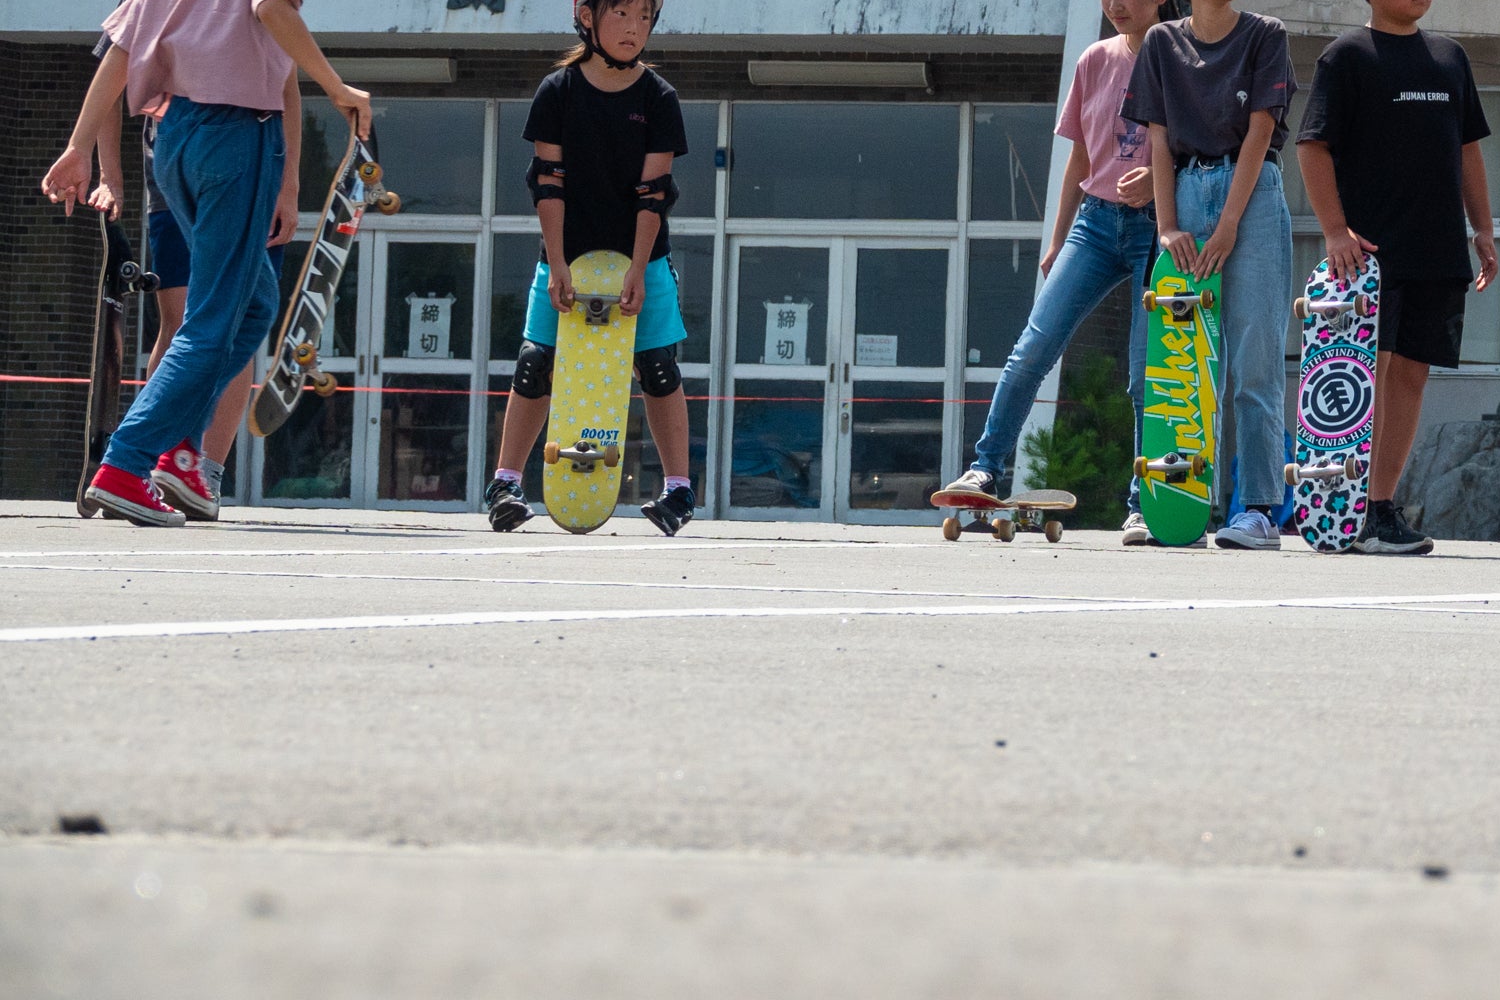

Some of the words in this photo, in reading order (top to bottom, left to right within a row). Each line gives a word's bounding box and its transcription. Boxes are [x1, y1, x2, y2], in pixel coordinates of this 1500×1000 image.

[1427, 92, 1450, 102] ERROR
[420, 303, 440, 354] 締切
[776, 309, 797, 360] 締切
[581, 428, 620, 440] BOOST
